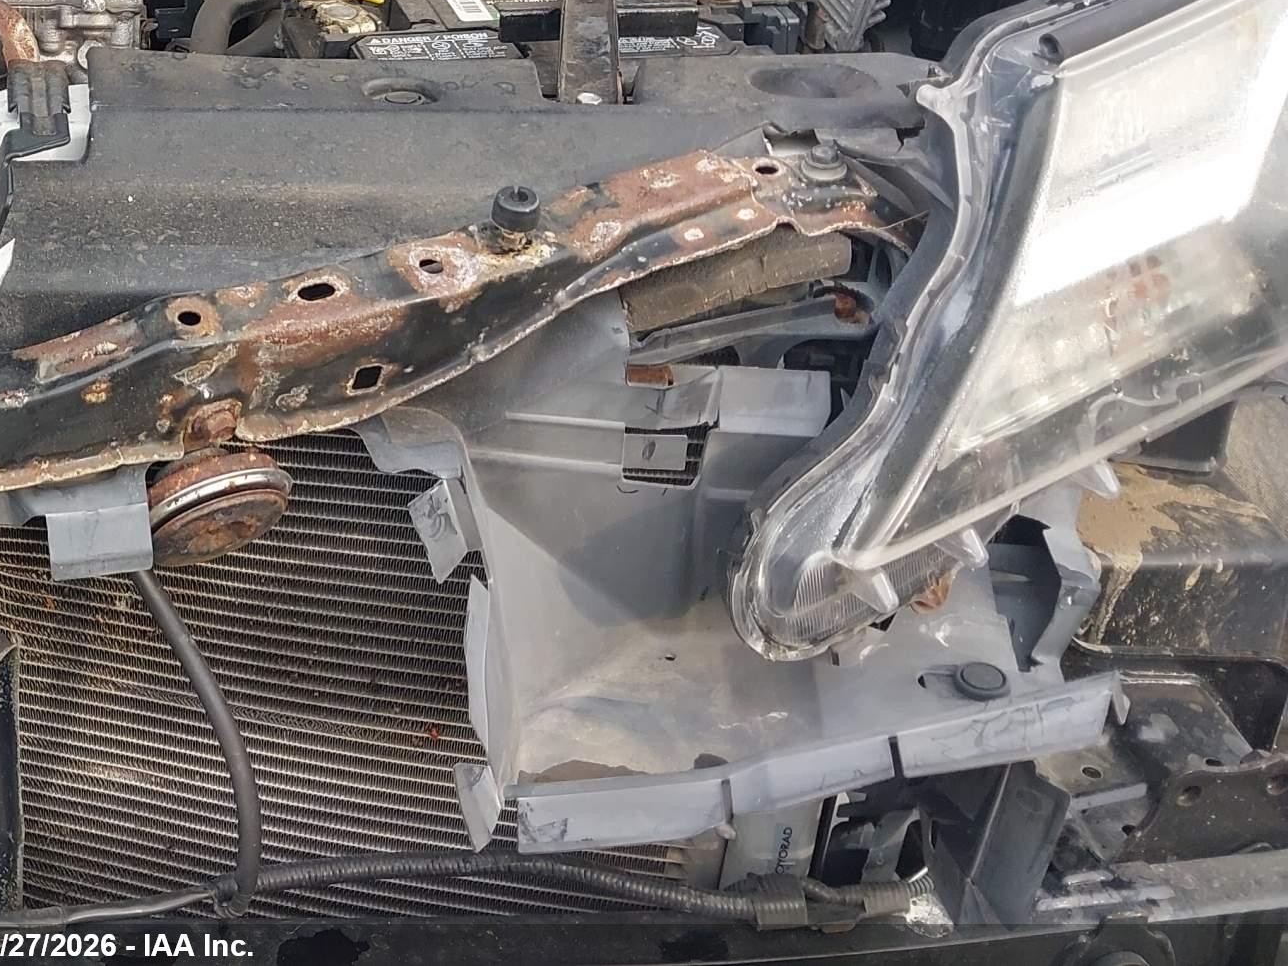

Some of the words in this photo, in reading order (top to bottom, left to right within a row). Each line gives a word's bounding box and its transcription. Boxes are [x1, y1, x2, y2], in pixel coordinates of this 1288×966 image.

[382, 35, 431, 44] DANGER
[443, 32, 489, 41] POISON
[775, 826, 793, 875] OYORAD
